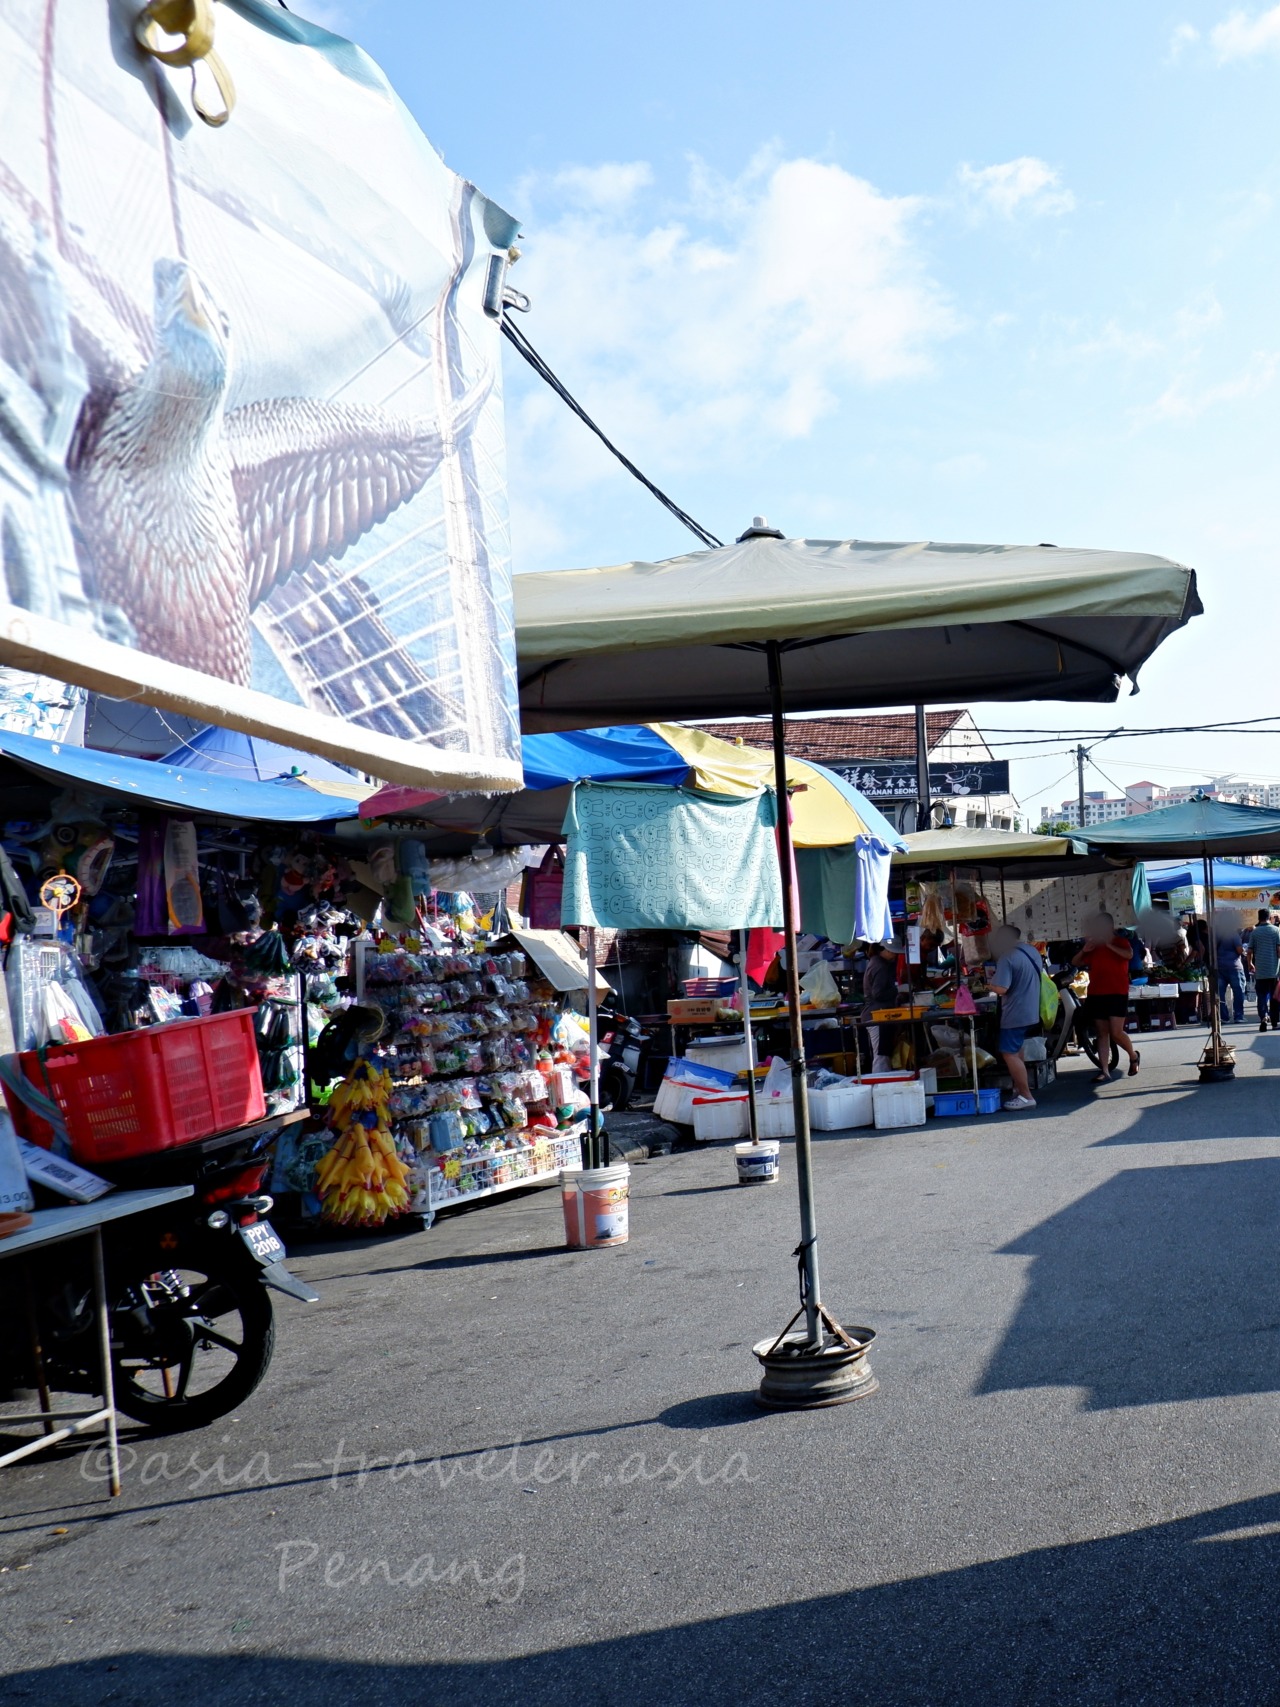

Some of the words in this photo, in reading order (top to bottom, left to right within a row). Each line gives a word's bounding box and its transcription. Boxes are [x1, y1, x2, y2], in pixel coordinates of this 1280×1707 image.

[860, 788, 893, 796] AKANAN
[246, 1223, 269, 1243] PPY
[253, 1236, 281, 1256] 2018
